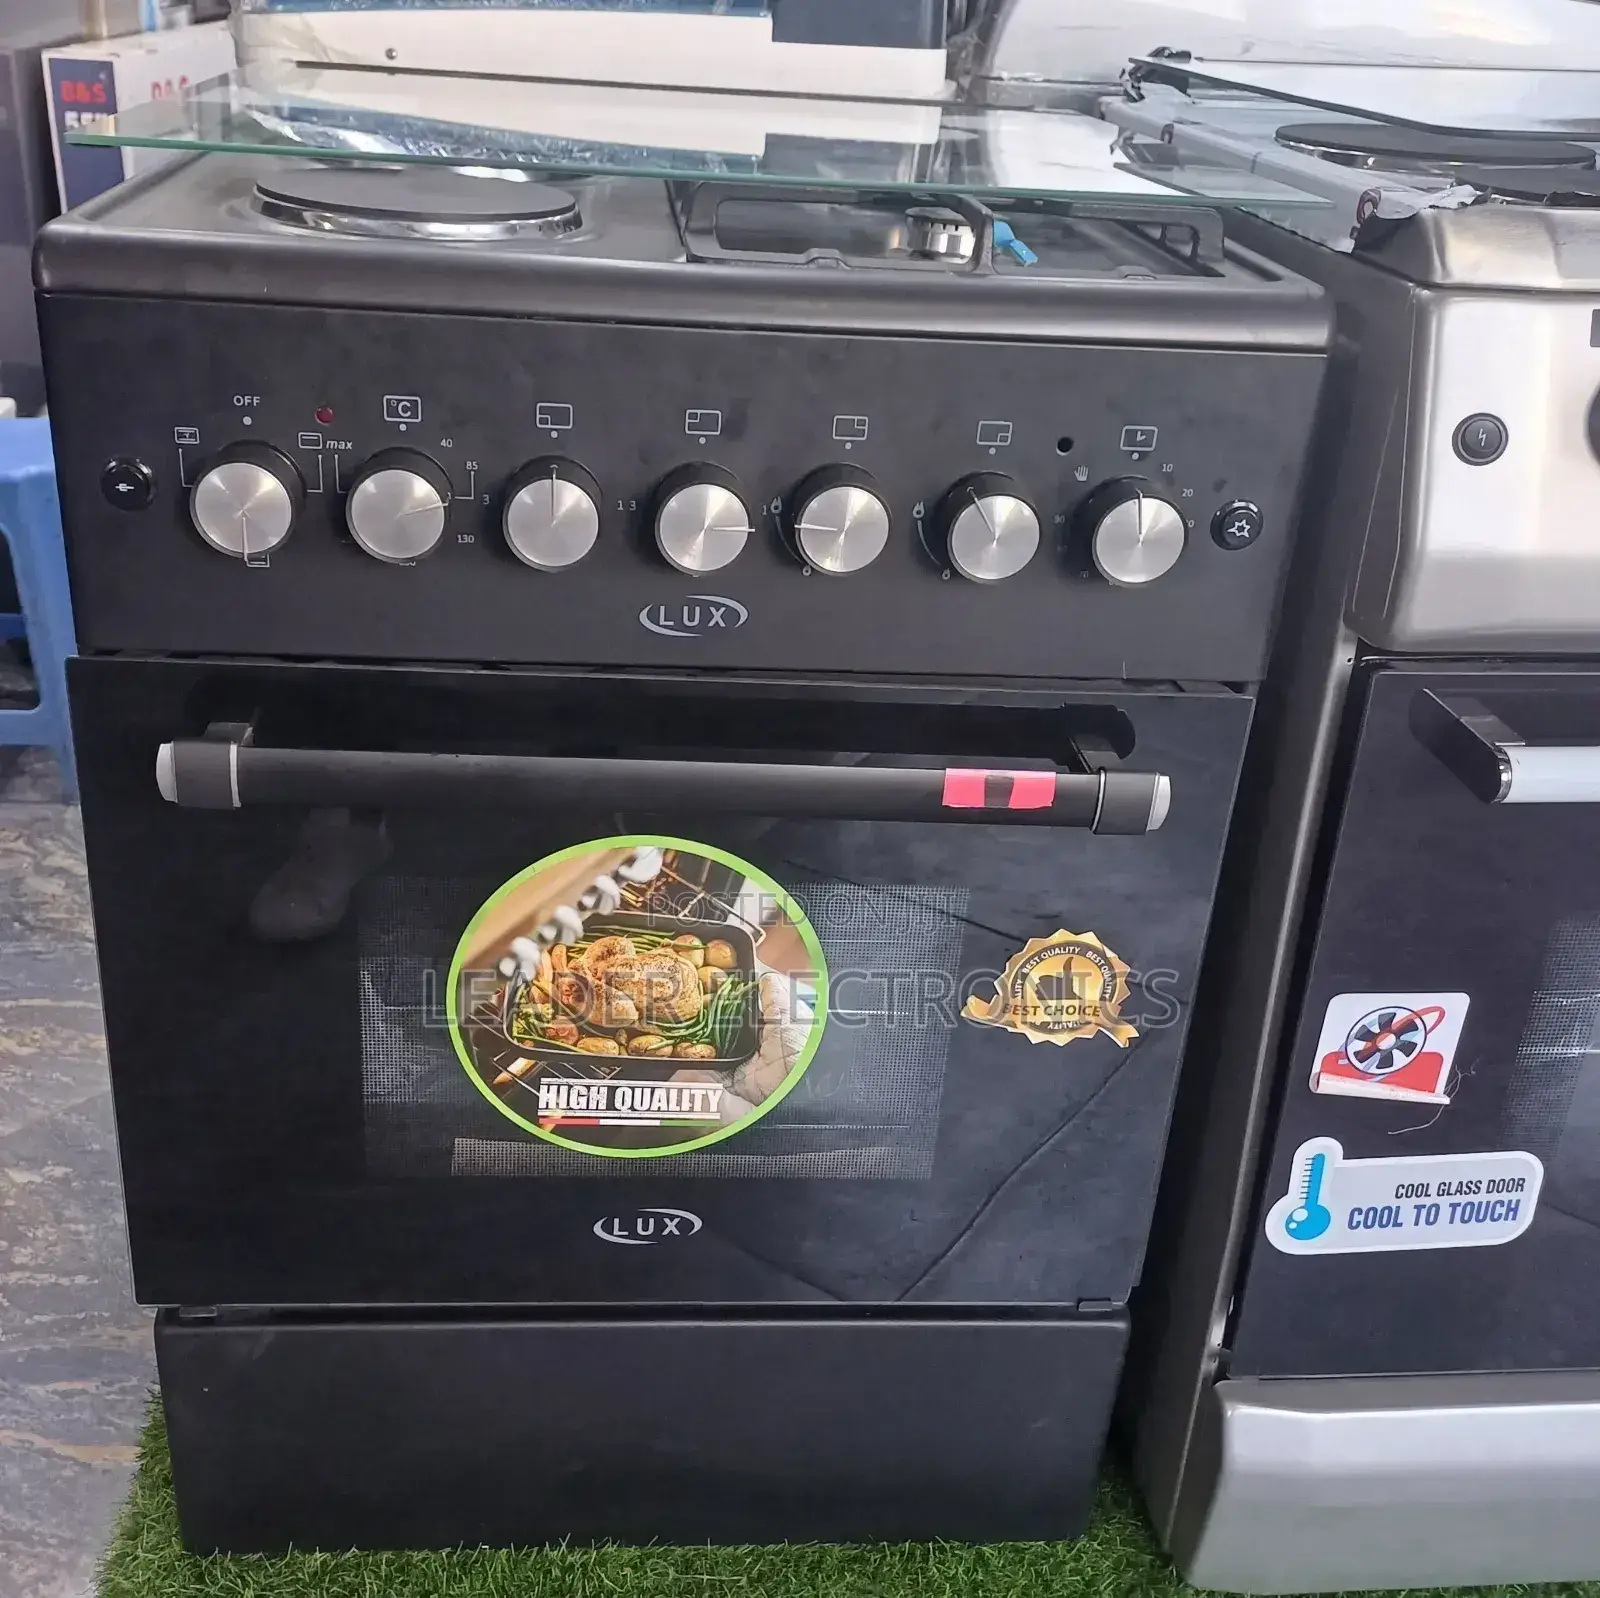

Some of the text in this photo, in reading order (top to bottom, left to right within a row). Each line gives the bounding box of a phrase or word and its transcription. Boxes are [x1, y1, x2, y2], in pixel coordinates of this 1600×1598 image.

[233, 395, 260, 407] OFF
[326, 440, 353, 450] max
[440, 438, 453, 448] 40
[466, 461, 479, 470] 85
[1162, 463, 1173, 472] 10
[1182, 489, 1194, 497] 20
[483, 495, 490, 505] 3
[457, 534, 475, 544] 130
[659, 605, 727, 627] LUX
[1022, 946, 1081, 974] BEST QUALITY
[1085, 950, 1113, 1000] BEST QUALITY
[1002, 1003, 1103, 1017] BEST CHOICE
[539, 1085, 724, 1113] HIGH QUALITY
[1395, 1177, 1526, 1199] COOL GLASS DOOR
[1347, 1199, 1521, 1230] COOL TO TOUCH
[613, 1217, 681, 1236] LUX
